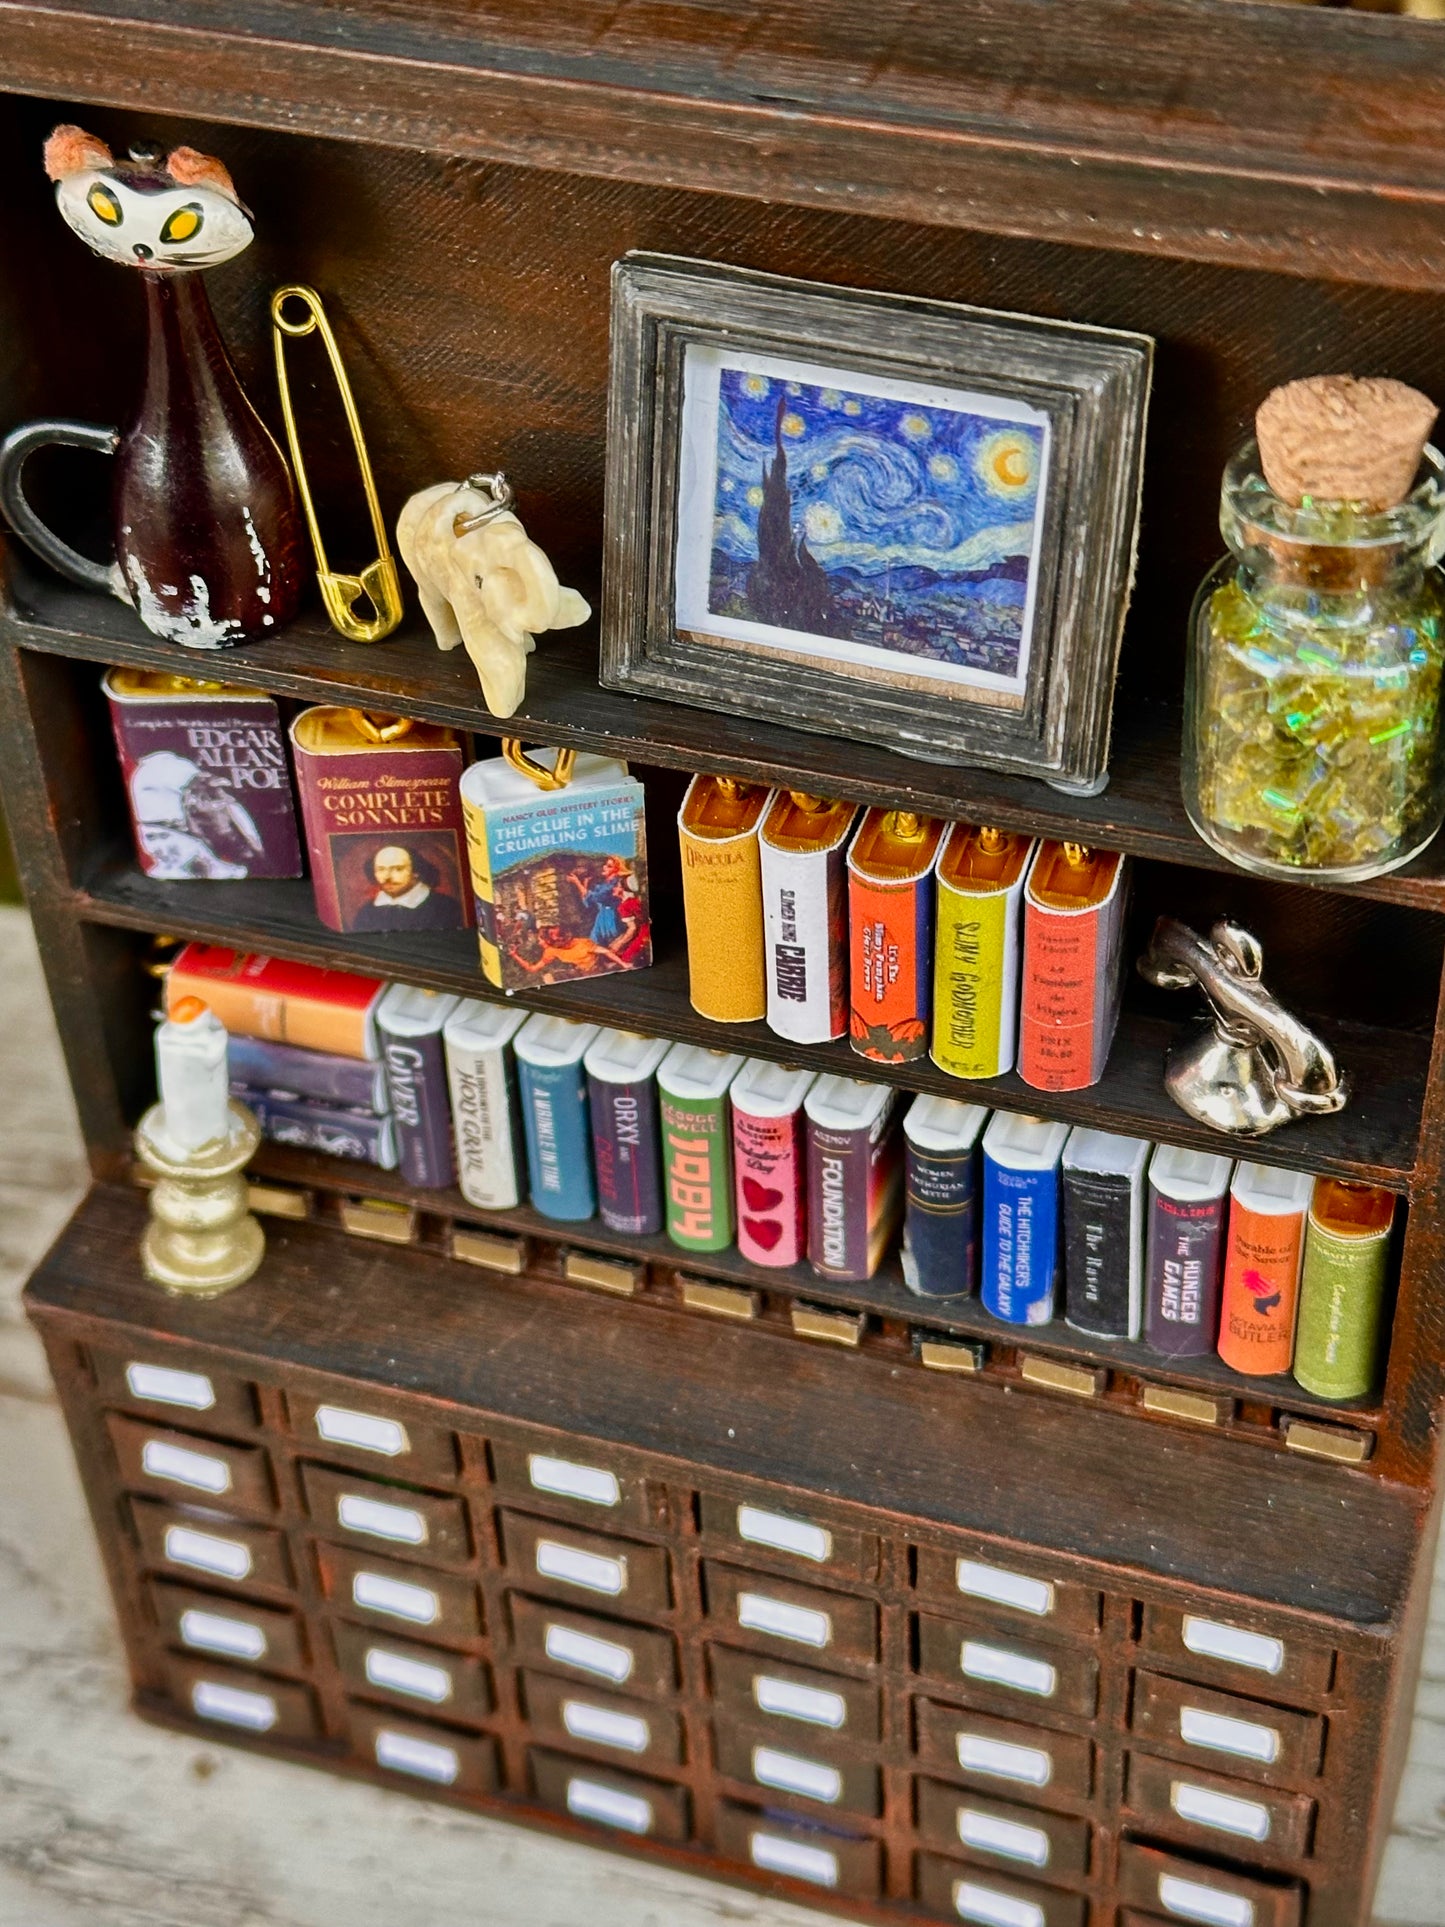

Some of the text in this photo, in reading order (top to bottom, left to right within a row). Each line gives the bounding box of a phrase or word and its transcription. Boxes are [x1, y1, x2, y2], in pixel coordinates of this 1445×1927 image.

[188, 728, 281, 748] EDGAR
[198, 749, 283, 767] ALLAN
[231, 768, 289, 789] POE
[317, 777, 369, 790] William
[323, 790, 450, 811] COMPLETE
[335, 808, 443, 826] SONNETS
[502, 796, 634, 824] NANCY GLUE MYSTERY STORIES
[495, 807, 630, 840] THE CLUE IN THE
[495, 819, 639, 855] CRUMBLING SLIME
[953, 922, 981, 965] SLIMY
[775, 944, 807, 1002] CARRIE
[949, 972, 980, 1049] GODMOTHER
[457, 1067, 480, 1117] HOLY
[534, 1087, 551, 1097] A
[534, 1099, 557, 1149] WRINKLE
[613, 1097, 641, 1145] ORXY
[814, 1130, 851, 1145] ASIMOV
[540, 1150, 558, 1163] IN
[916, 1164, 954, 1177] WOMEN
[541, 1164, 561, 1193] TIME
[668, 1133, 713, 1239] 1984
[821, 1157, 846, 1268] FOUNDATION
[1017, 1196, 1032, 1217] THE
[997, 1203, 1013, 1317] GUIDE TO THE GALAXY
[1086, 1224, 1103, 1301] The Raven
[1161, 1259, 1182, 1322] GAMES
[1177, 1236, 1201, 1324] THE HUNGER
